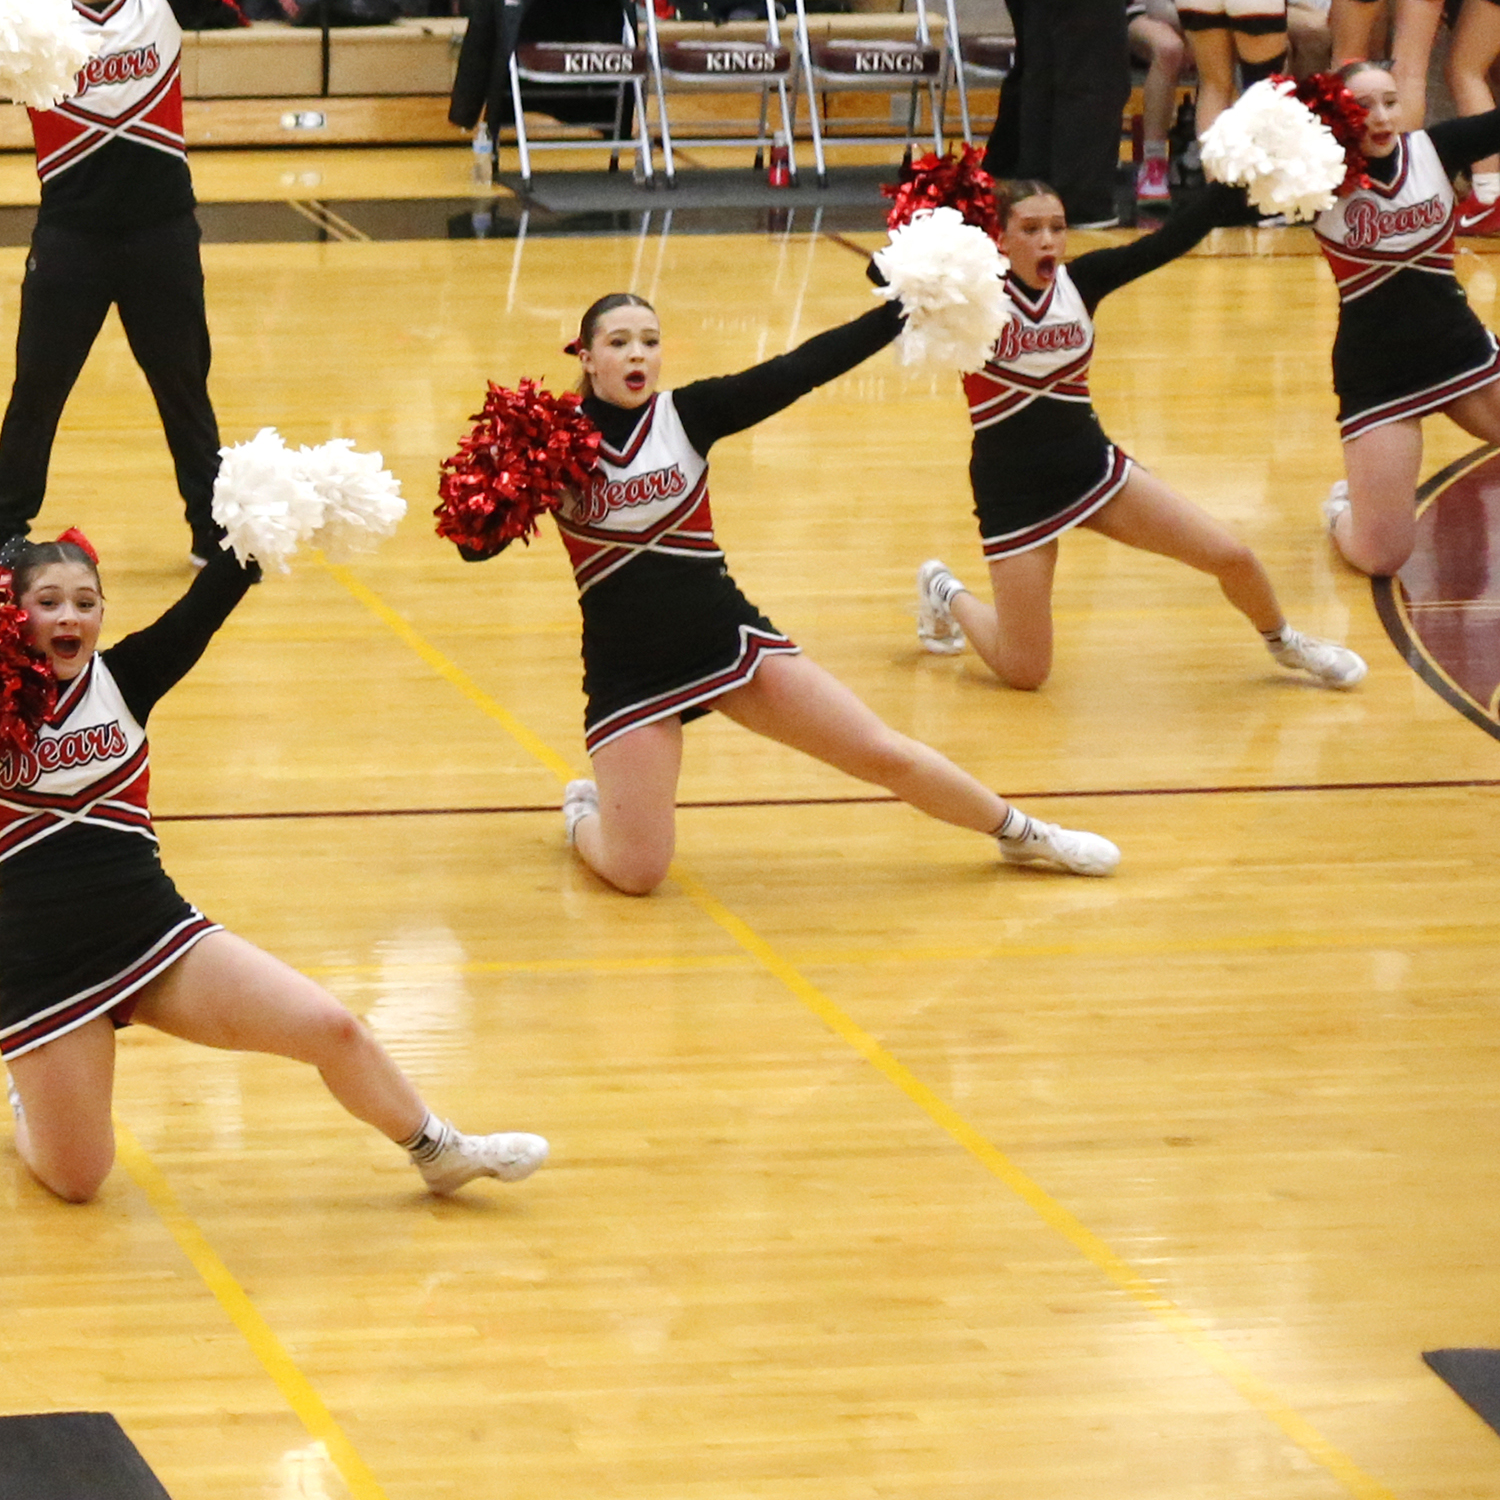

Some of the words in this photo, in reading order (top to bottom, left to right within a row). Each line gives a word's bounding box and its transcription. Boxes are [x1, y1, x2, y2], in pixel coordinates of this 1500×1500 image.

[75, 42, 162, 98] ears
[564, 52, 634, 72] KINGS
[706, 52, 775, 72] KINGS
[856, 51, 924, 72] KINGS
[1344, 194, 1446, 250] Bears
[993, 314, 1086, 362] Bears
[581, 462, 689, 524] Bears
